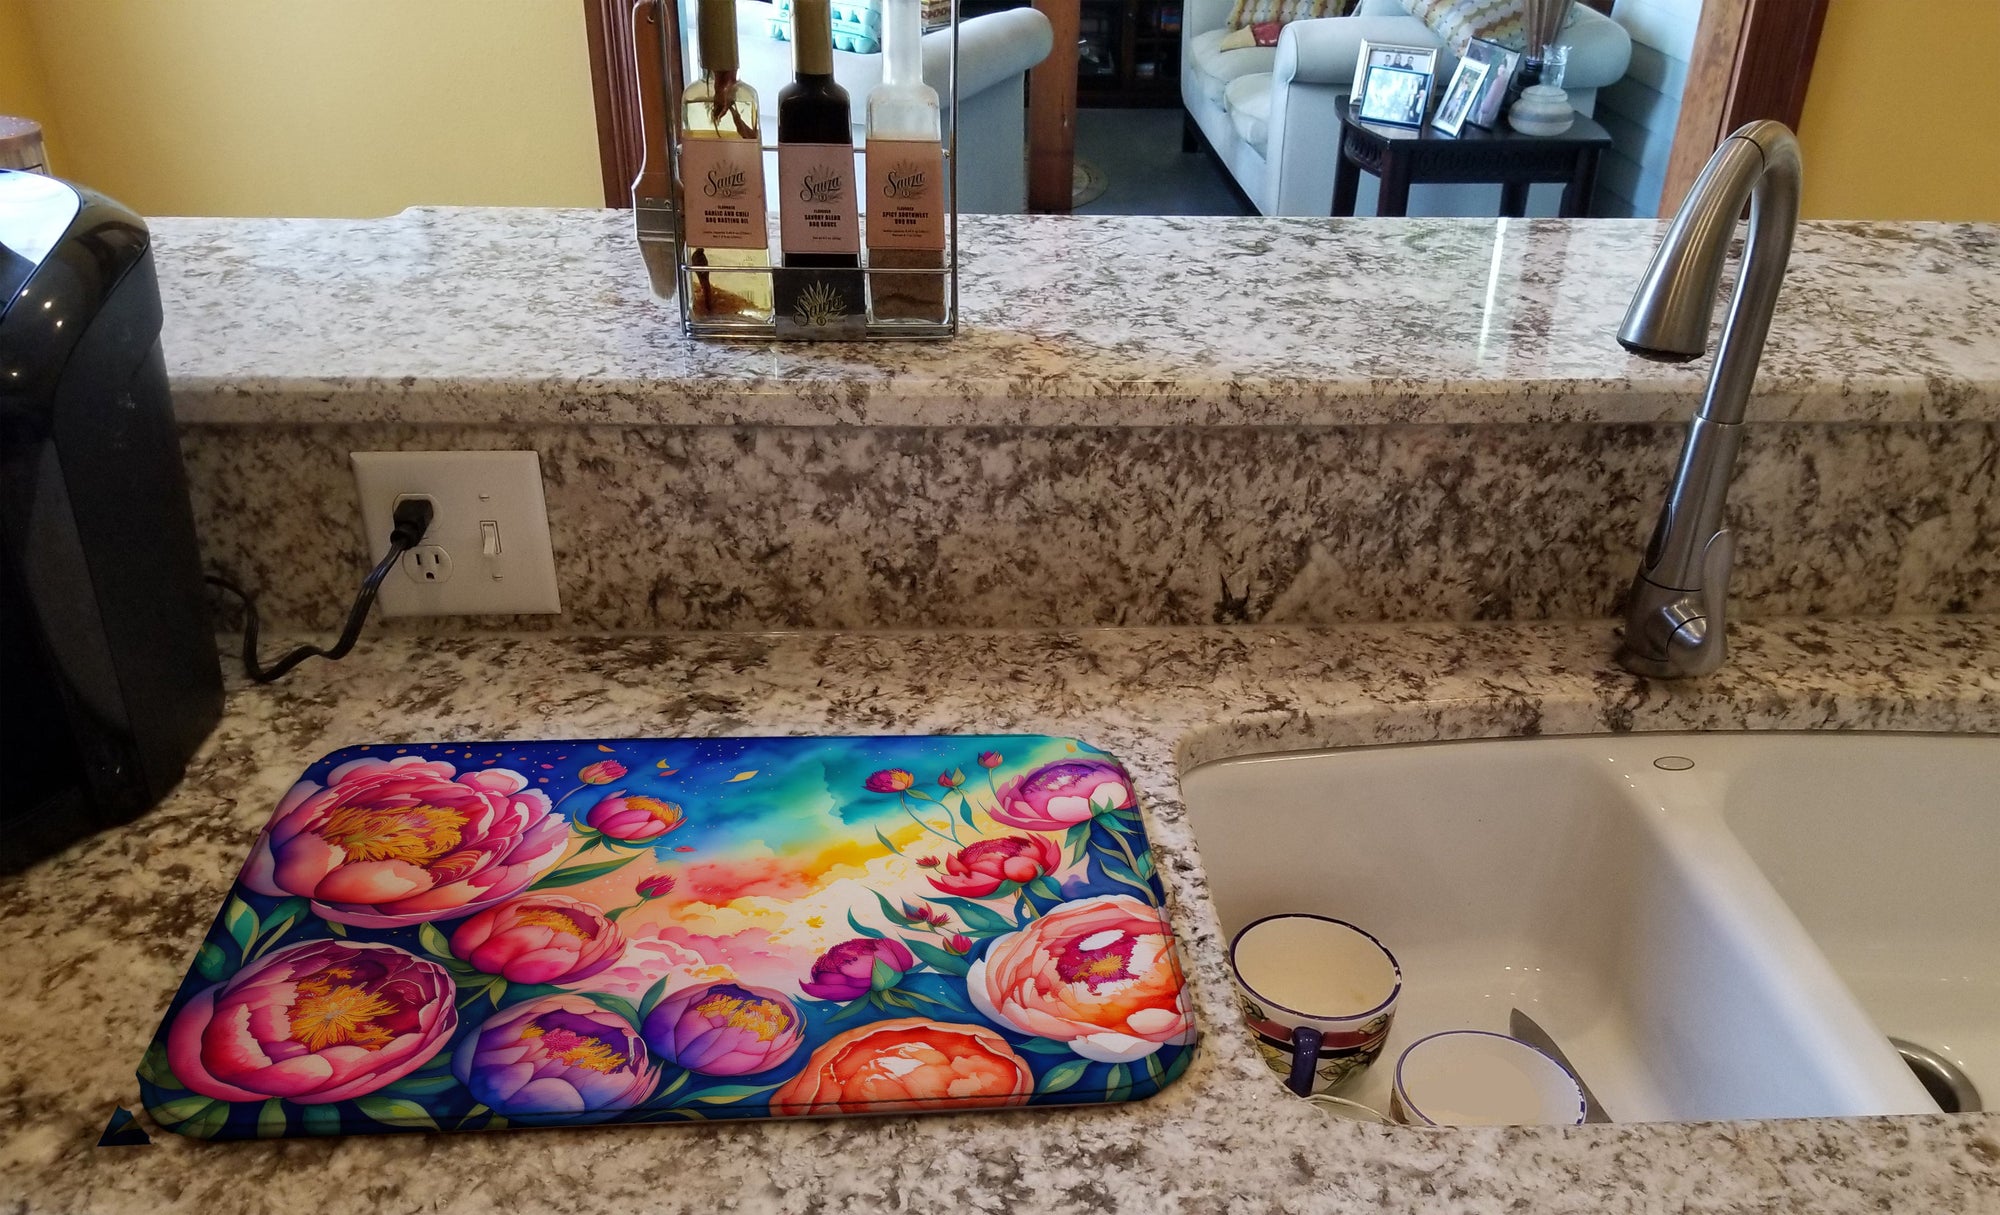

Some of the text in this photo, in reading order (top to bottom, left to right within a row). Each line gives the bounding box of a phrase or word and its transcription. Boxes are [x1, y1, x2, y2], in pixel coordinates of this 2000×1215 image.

[703, 169, 745, 197] Sauza
[799, 175, 842, 202] Sauza
[883, 171, 926, 198] Sauza
